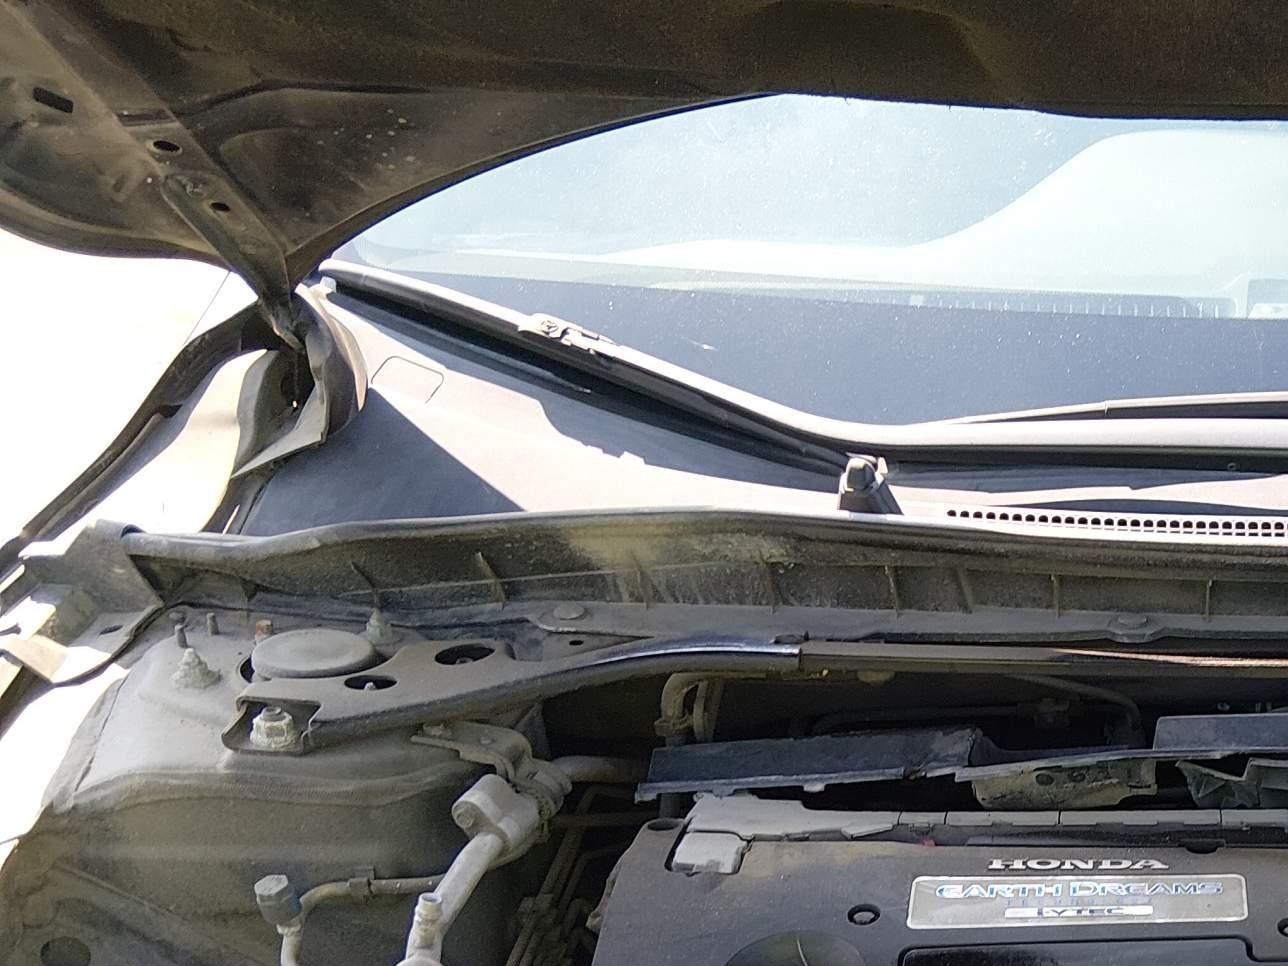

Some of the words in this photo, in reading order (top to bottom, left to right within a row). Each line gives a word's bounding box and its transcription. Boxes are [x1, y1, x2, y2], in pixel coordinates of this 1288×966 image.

[988, 858, 1169, 871] HONDA
[936, 882, 1061, 898] EARTH
[1069, 880, 1224, 897] DREAMS
